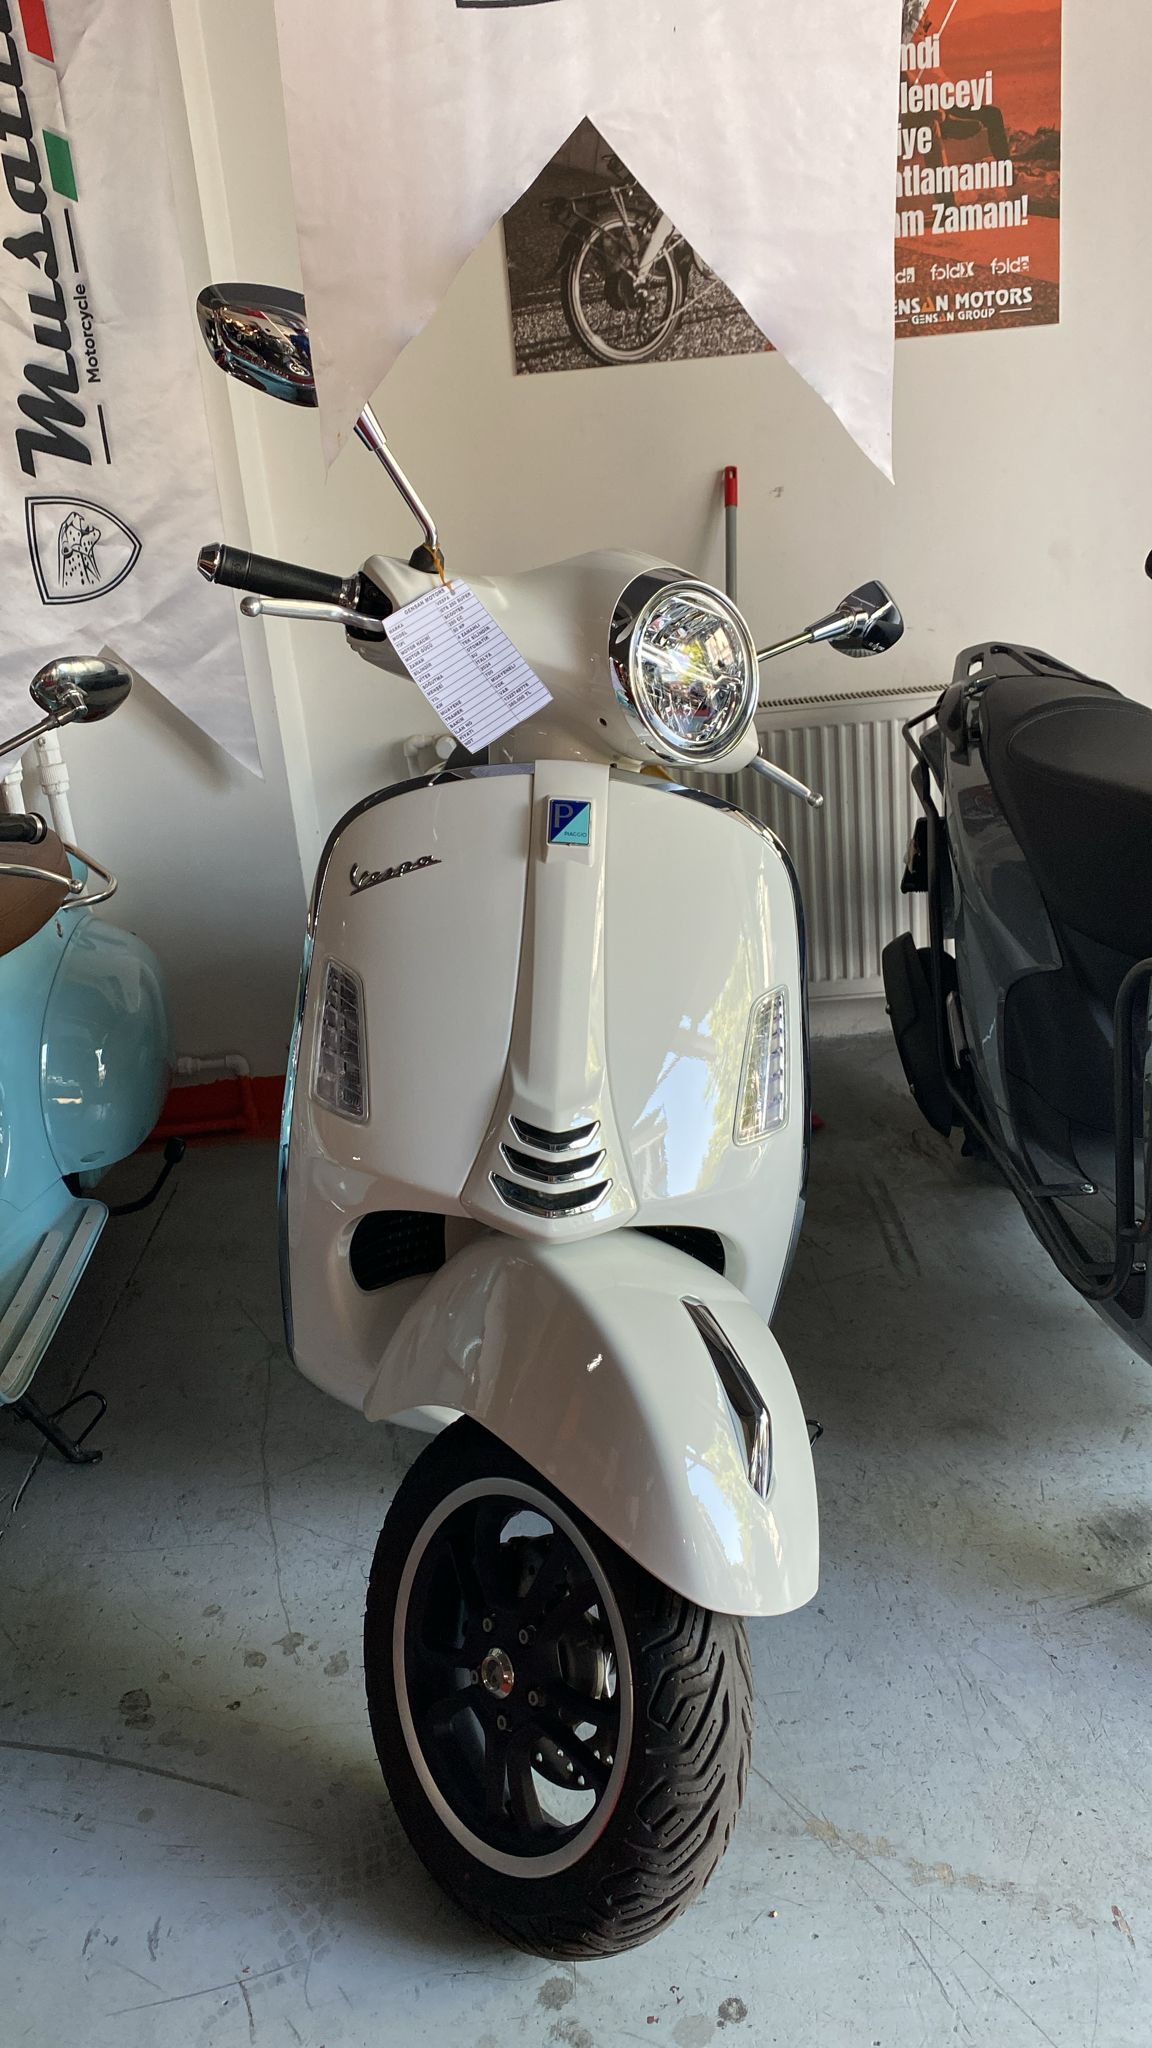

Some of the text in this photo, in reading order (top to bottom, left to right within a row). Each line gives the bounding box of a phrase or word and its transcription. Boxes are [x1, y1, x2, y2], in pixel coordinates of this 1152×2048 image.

[900, 33, 940, 71] mdi
[900, 70, 992, 114] lenceyi
[932, 194, 1029, 235] Zamanı!
[955, 286, 1033, 310] MOTORS
[911, 306, 996, 325] GENSAN GROUP
[73, 283, 101, 383] Motorcycle
[425, 589, 445, 602] MOTORS
[444, 606, 464, 619] SCOOTER
[401, 645, 416, 655] MOTOR
[405, 651, 421, 662] MOTOR
[440, 700, 462, 715] MUAYENE
[554, 803, 574, 829] P
[349, 854, 442, 896] Vespa
